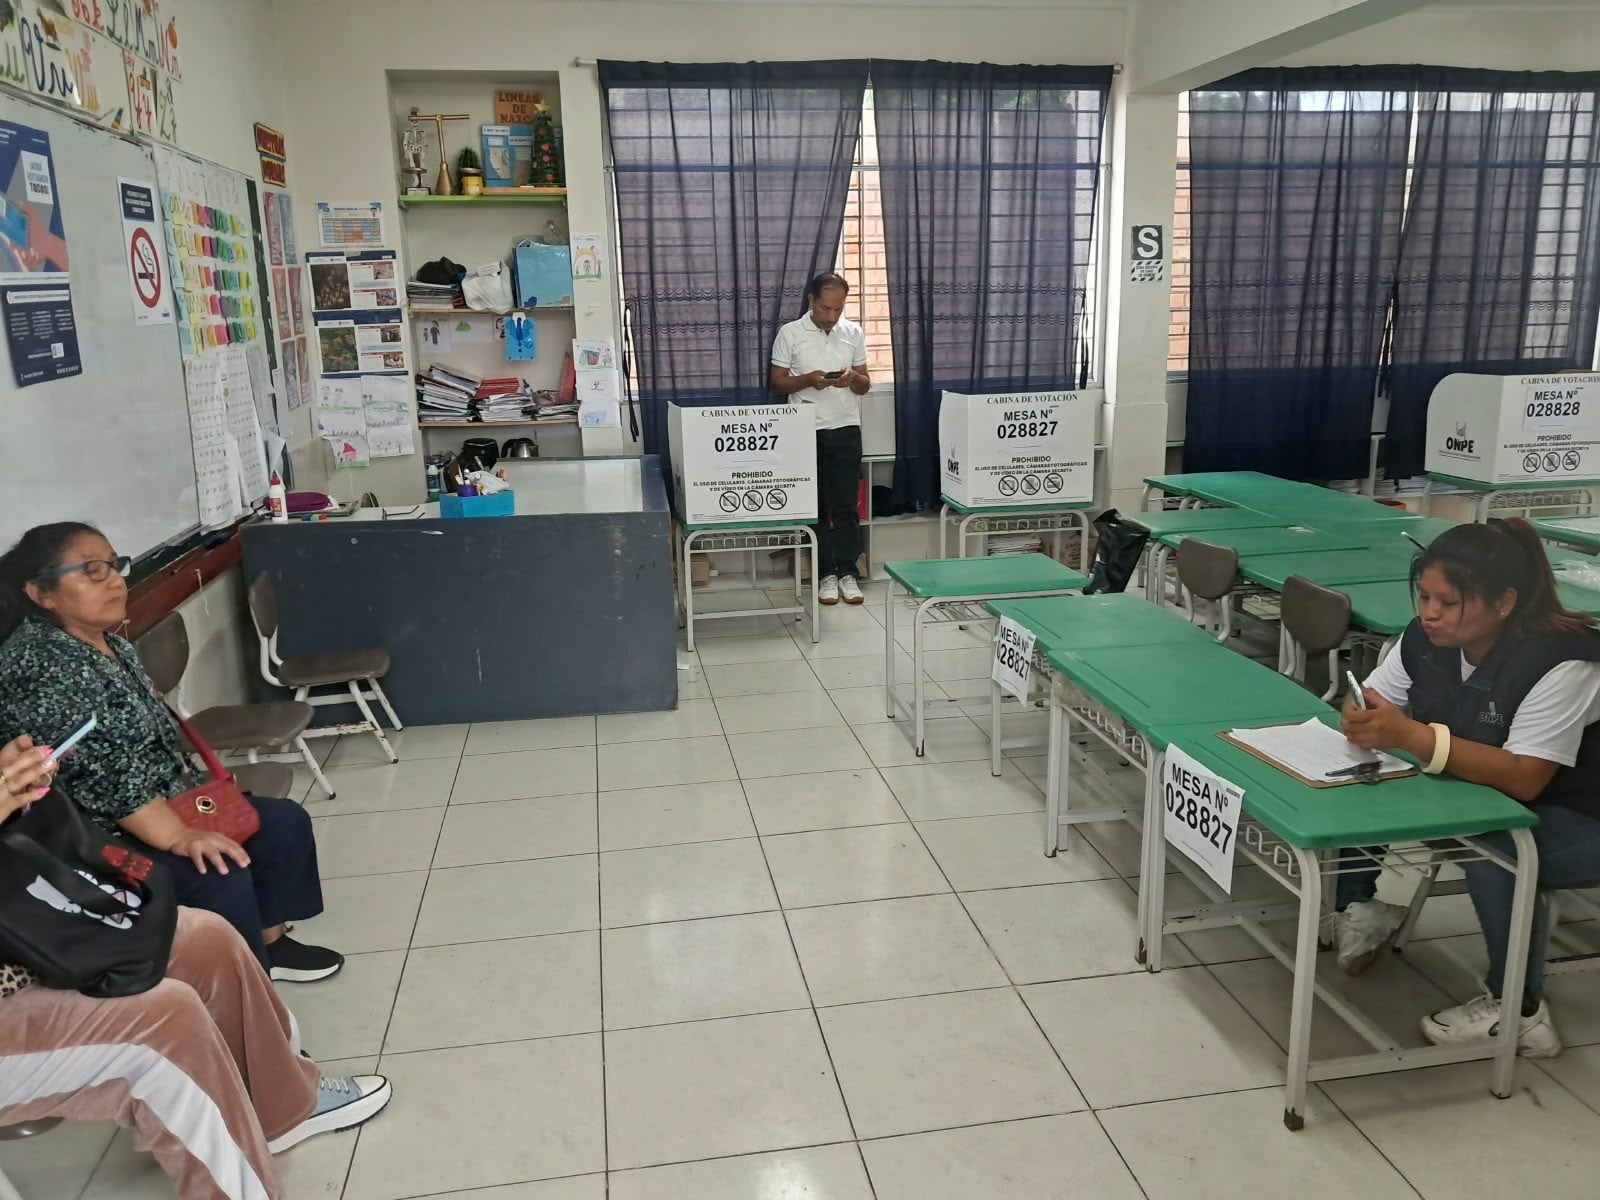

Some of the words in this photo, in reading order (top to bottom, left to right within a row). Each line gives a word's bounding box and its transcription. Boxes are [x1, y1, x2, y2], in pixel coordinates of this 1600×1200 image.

[512, 103, 527, 114] DE
[1137, 227, 1160, 258] S
[1521, 377, 1550, 385] CABINA
[1551, 376, 1561, 384] DE
[987, 396, 1019, 405] CABINA
[1021, 395, 1033, 403] DE
[1035, 392, 1078, 402] VOTACIÓN
[1534, 390, 1563, 400] MESA
[701, 409, 736, 418] CABINA
[738, 408, 750, 417] DE
[752, 405, 798, 416] VOTACIÓN
[1004, 410, 1037, 421] MESA
[1526, 402, 1581, 417] 028828
[721, 423, 756, 434] MESA
[997, 421, 1058, 439] 028827
[714, 435, 779, 453] 028827
[1446, 436, 1475, 453] ONPE
[1011, 455, 1051, 464] PROHIBIDO
[731, 470, 774, 479] PROHIBIDO
[1000, 624, 1021, 650] MESA
[996, 640, 1030, 681] 028827
[1172, 762, 1212, 805] MESA
[1165, 782, 1233, 855] 028827
